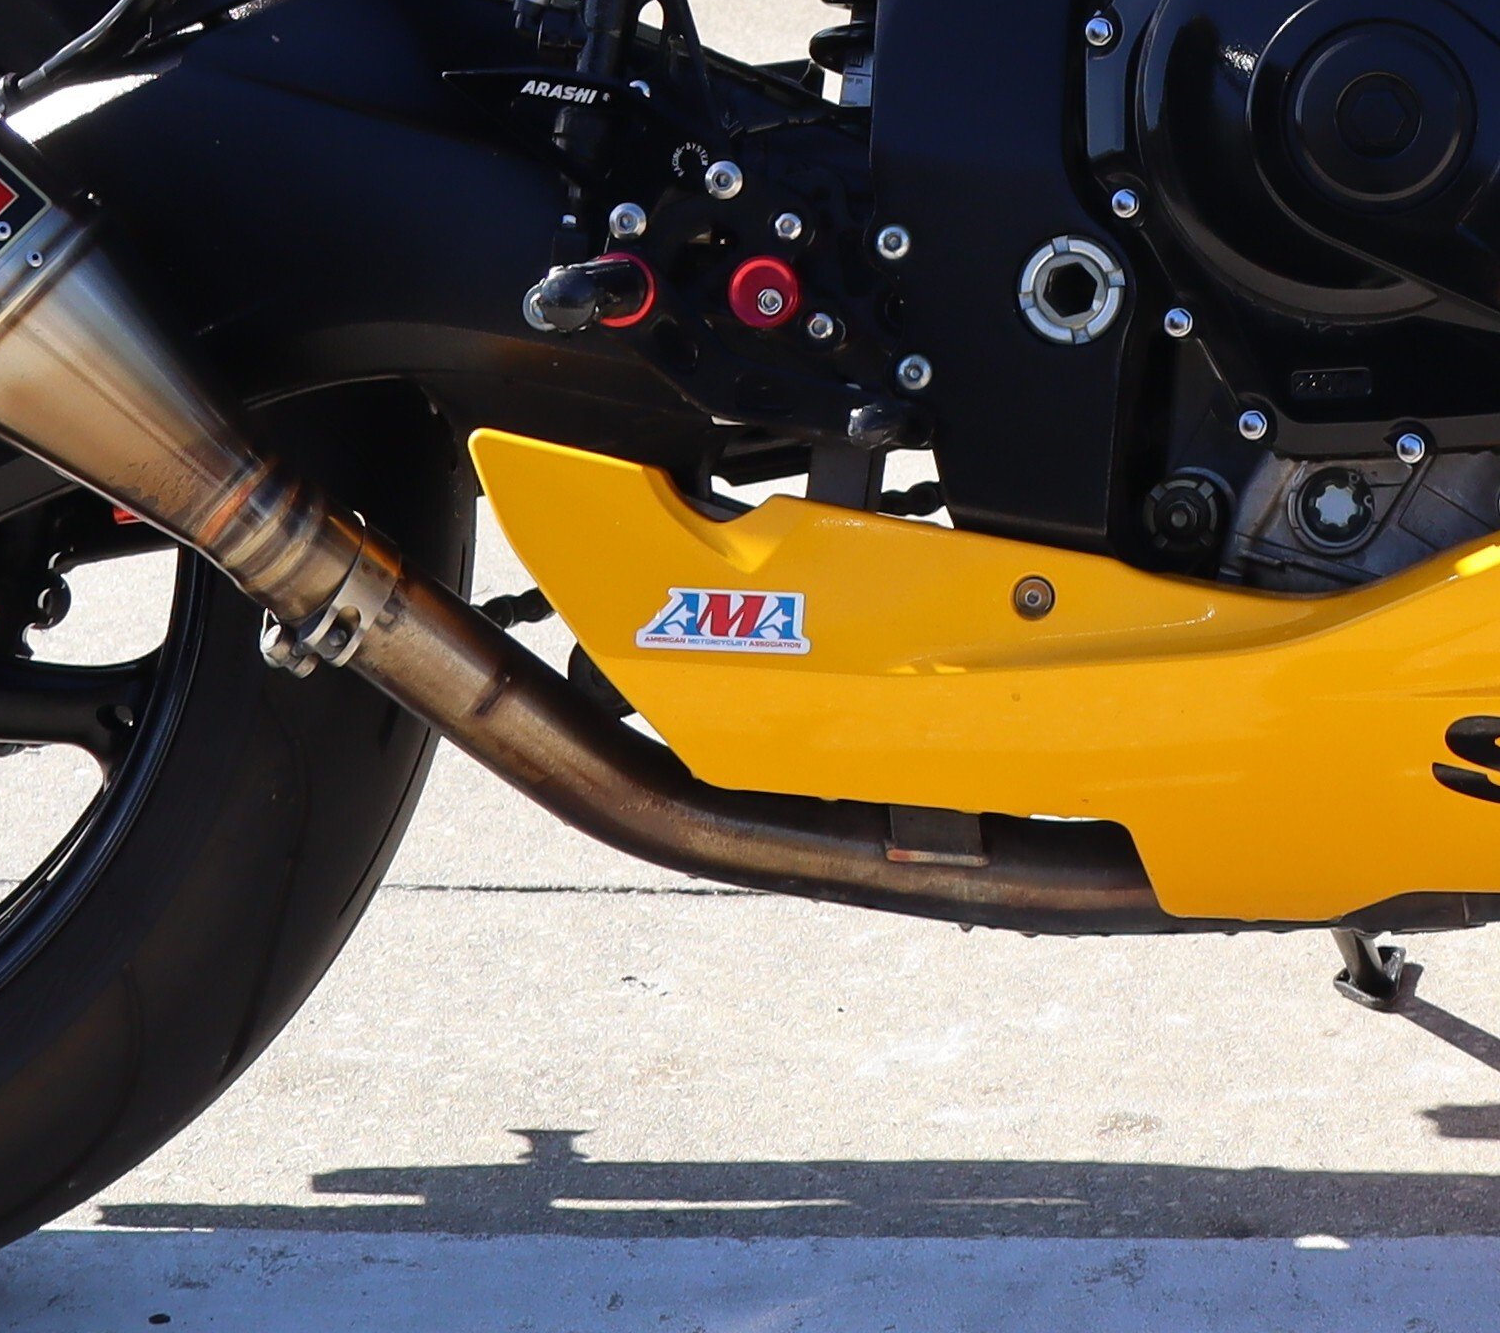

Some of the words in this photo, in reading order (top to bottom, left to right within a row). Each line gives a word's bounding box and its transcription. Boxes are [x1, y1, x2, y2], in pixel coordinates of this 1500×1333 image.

[521, 80, 597, 104] ARASHI
[649, 592, 800, 640] AMA
[644, 636, 686, 644] AMERICAN
[749, 640, 802, 649] ASSOCIATION
